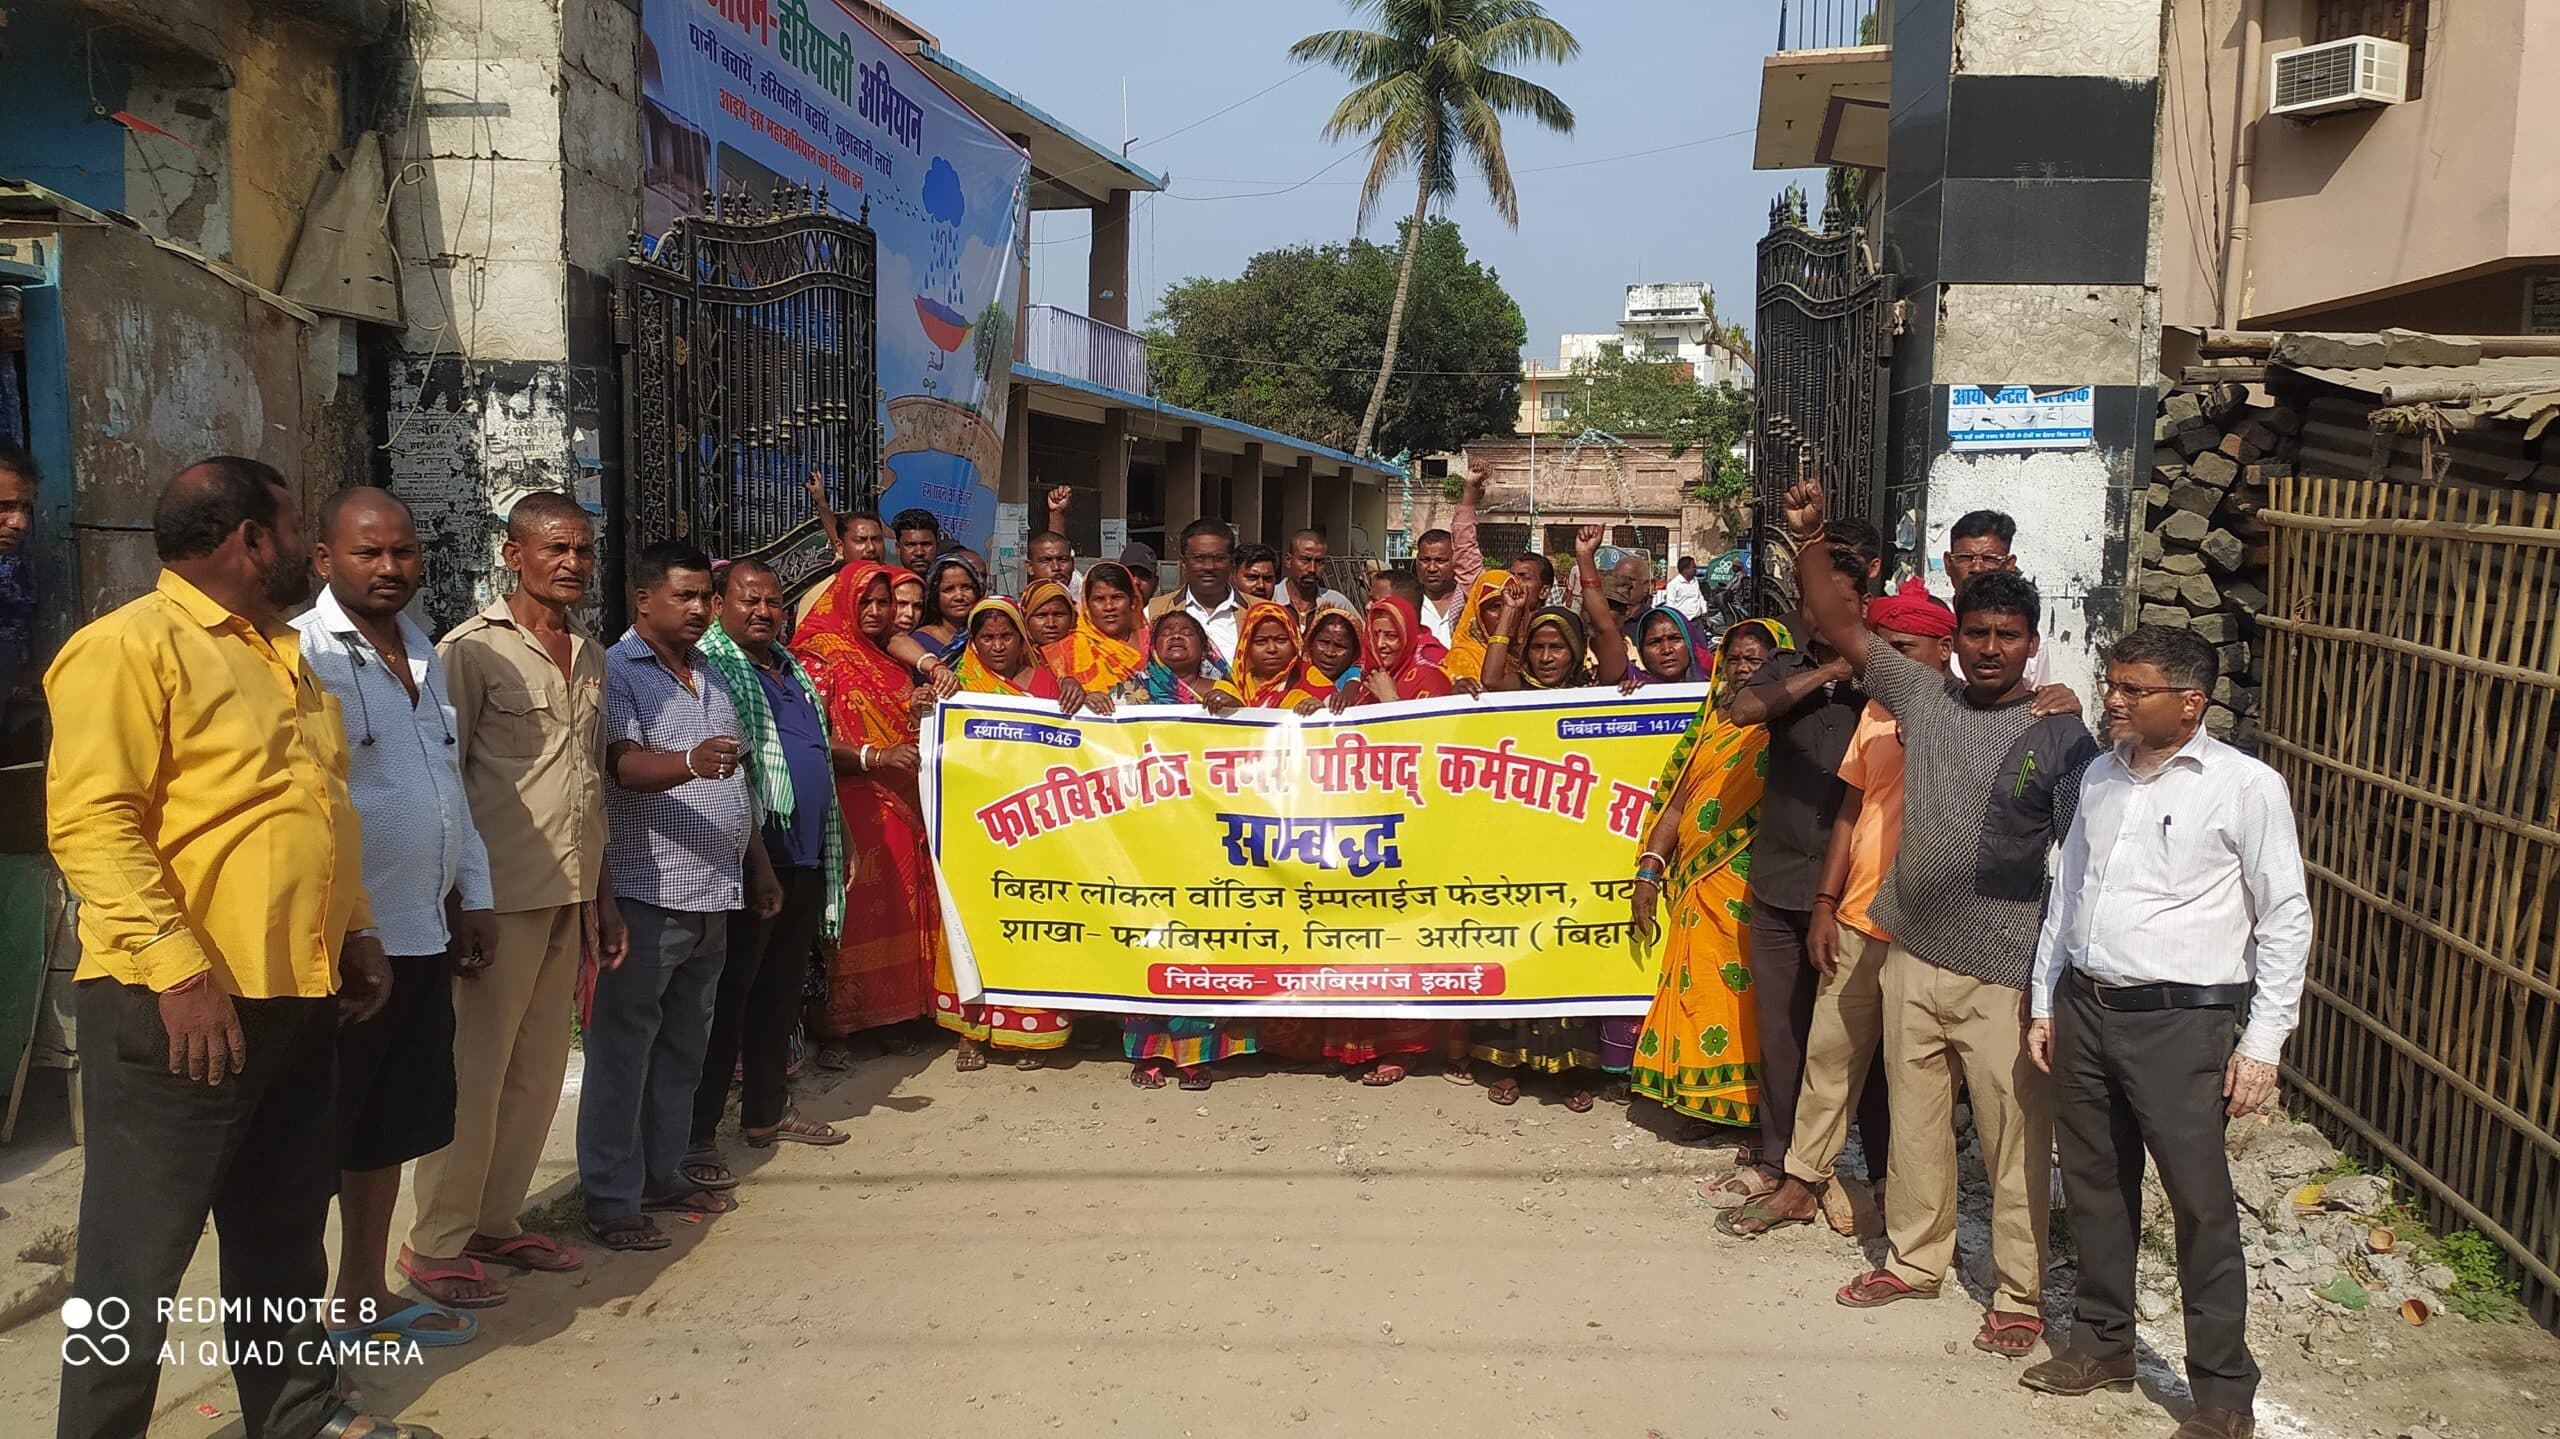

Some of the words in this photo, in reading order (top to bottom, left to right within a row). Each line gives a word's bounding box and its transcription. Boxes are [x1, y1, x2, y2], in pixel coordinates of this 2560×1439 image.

[689, 23, 718, 64] पानी
[720, 44, 757, 94] बचायें,
[760, 70, 803, 119] हरियाली
[835, 123, 874, 166] खुशहाली
[874, 151, 894, 179] लायें
[858, 60, 924, 156] अभियान
[719, 87, 747, 122] आइये
[749, 106, 764, 132] इस
[766, 117, 817, 165] महाअभियान
[818, 151, 829, 173] का
[1038, 730, 1073, 746] 1946
[1560, 720, 1602, 736] निबंधन
[976, 743, 1192, 847] फारबिसगंज
[1306, 733, 1424, 805] परिषद्
[1436, 739, 1599, 820] कर्मचारी
[1609, 780, 1658, 839] सं
[1216, 813, 1404, 877] सम्बद्ध
[991, 869, 1072, 904] बिहार
[1078, 876, 1177, 908] लोकल
[1294, 880, 1438, 914] ईम्पलाईज
[1444, 876, 1577, 908] फेडरेशन,
[1109, 920, 1289, 954] फारबिसगंज,
[1416, 918, 1519, 948] अररिया
[1275, 967, 1412, 991] फारबिसगंज
[1418, 965, 1484, 994] इकाई
